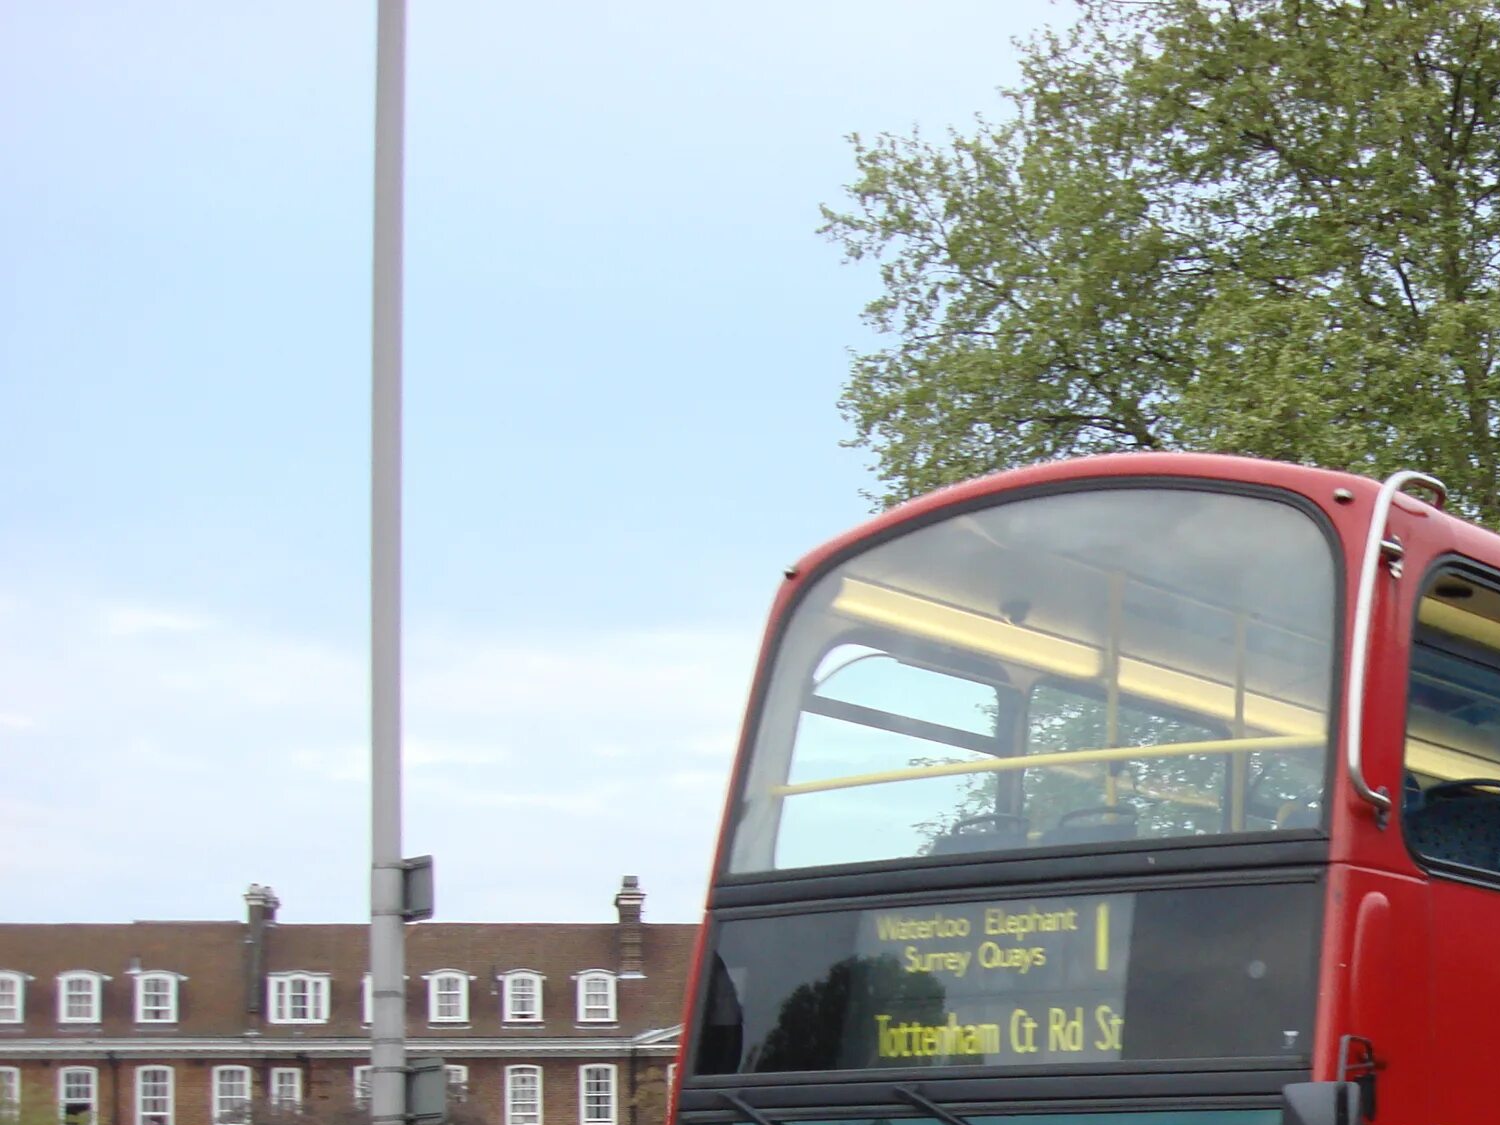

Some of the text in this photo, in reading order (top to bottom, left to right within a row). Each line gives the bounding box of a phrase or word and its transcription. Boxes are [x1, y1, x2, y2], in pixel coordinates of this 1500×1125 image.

[876, 904, 1079, 942] Waterloo Elephant
[904, 940, 1047, 977] Surrey Quays
[874, 1004, 1125, 1057] Tottenham Ct Rd St
